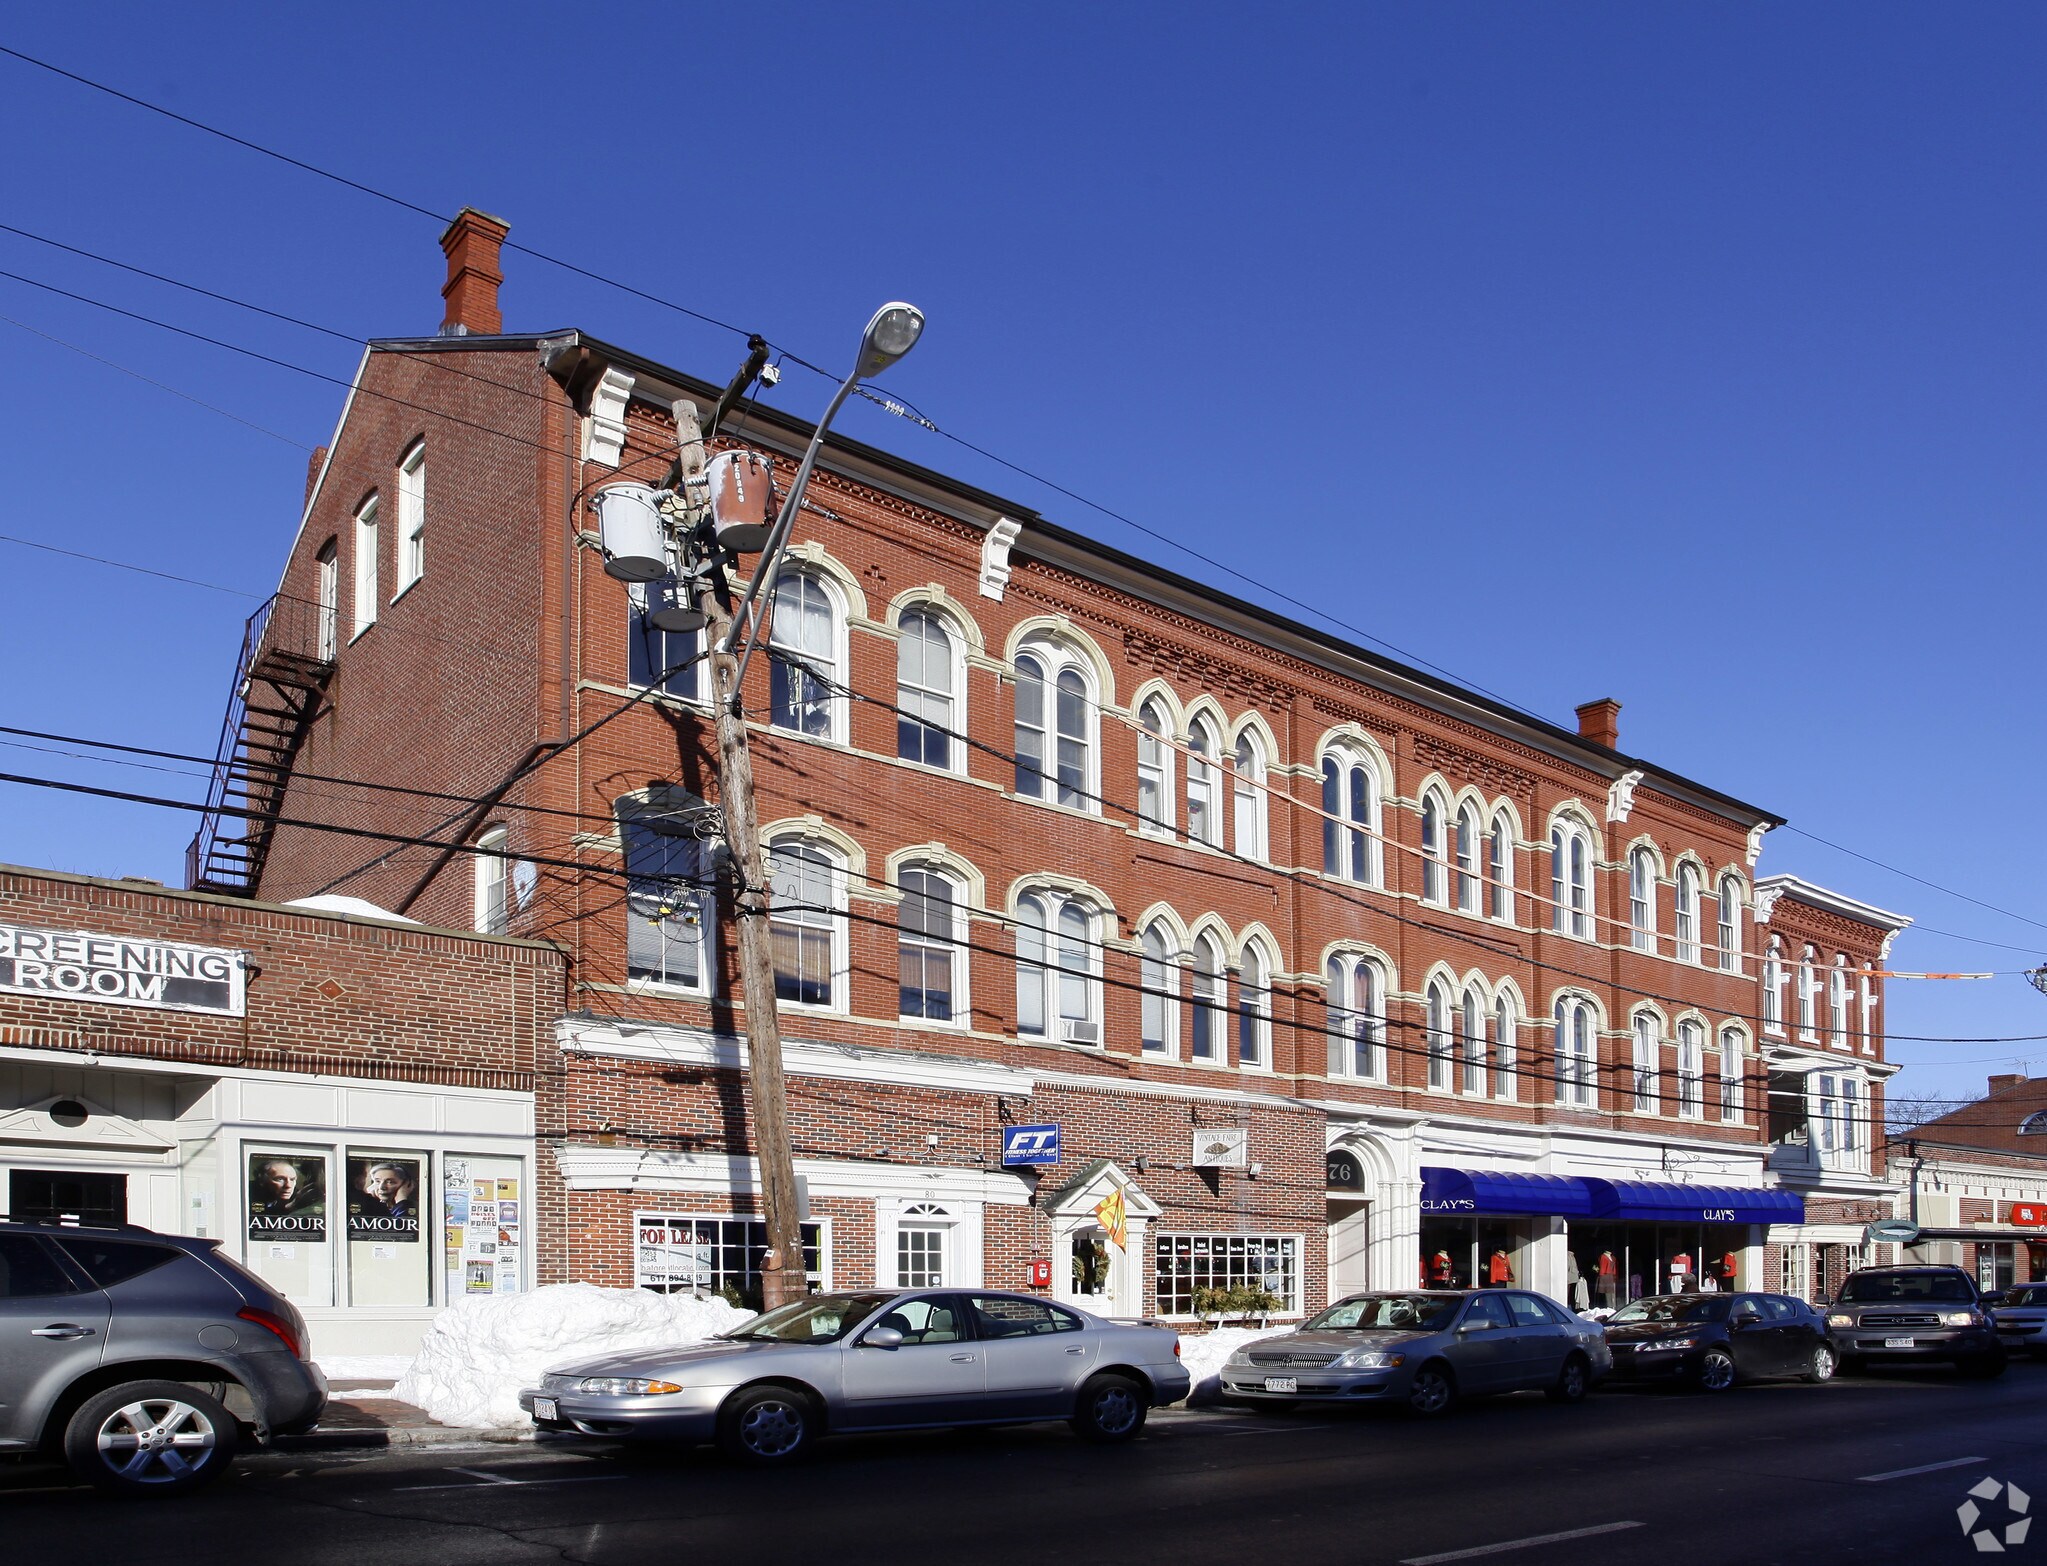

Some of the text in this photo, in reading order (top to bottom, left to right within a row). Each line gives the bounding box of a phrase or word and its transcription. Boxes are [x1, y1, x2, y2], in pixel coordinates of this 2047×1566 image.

[14, 959, 163, 1001] ROOM
[1009, 1131, 1056, 1149] FT
[1328, 1163, 1351, 1181] 76
[925, 1190, 936, 1199] 80
[249, 1216, 327, 1231] AMOUR
[348, 1217, 419, 1231] AMOUR
[640, 1229, 665, 1244] FOR
